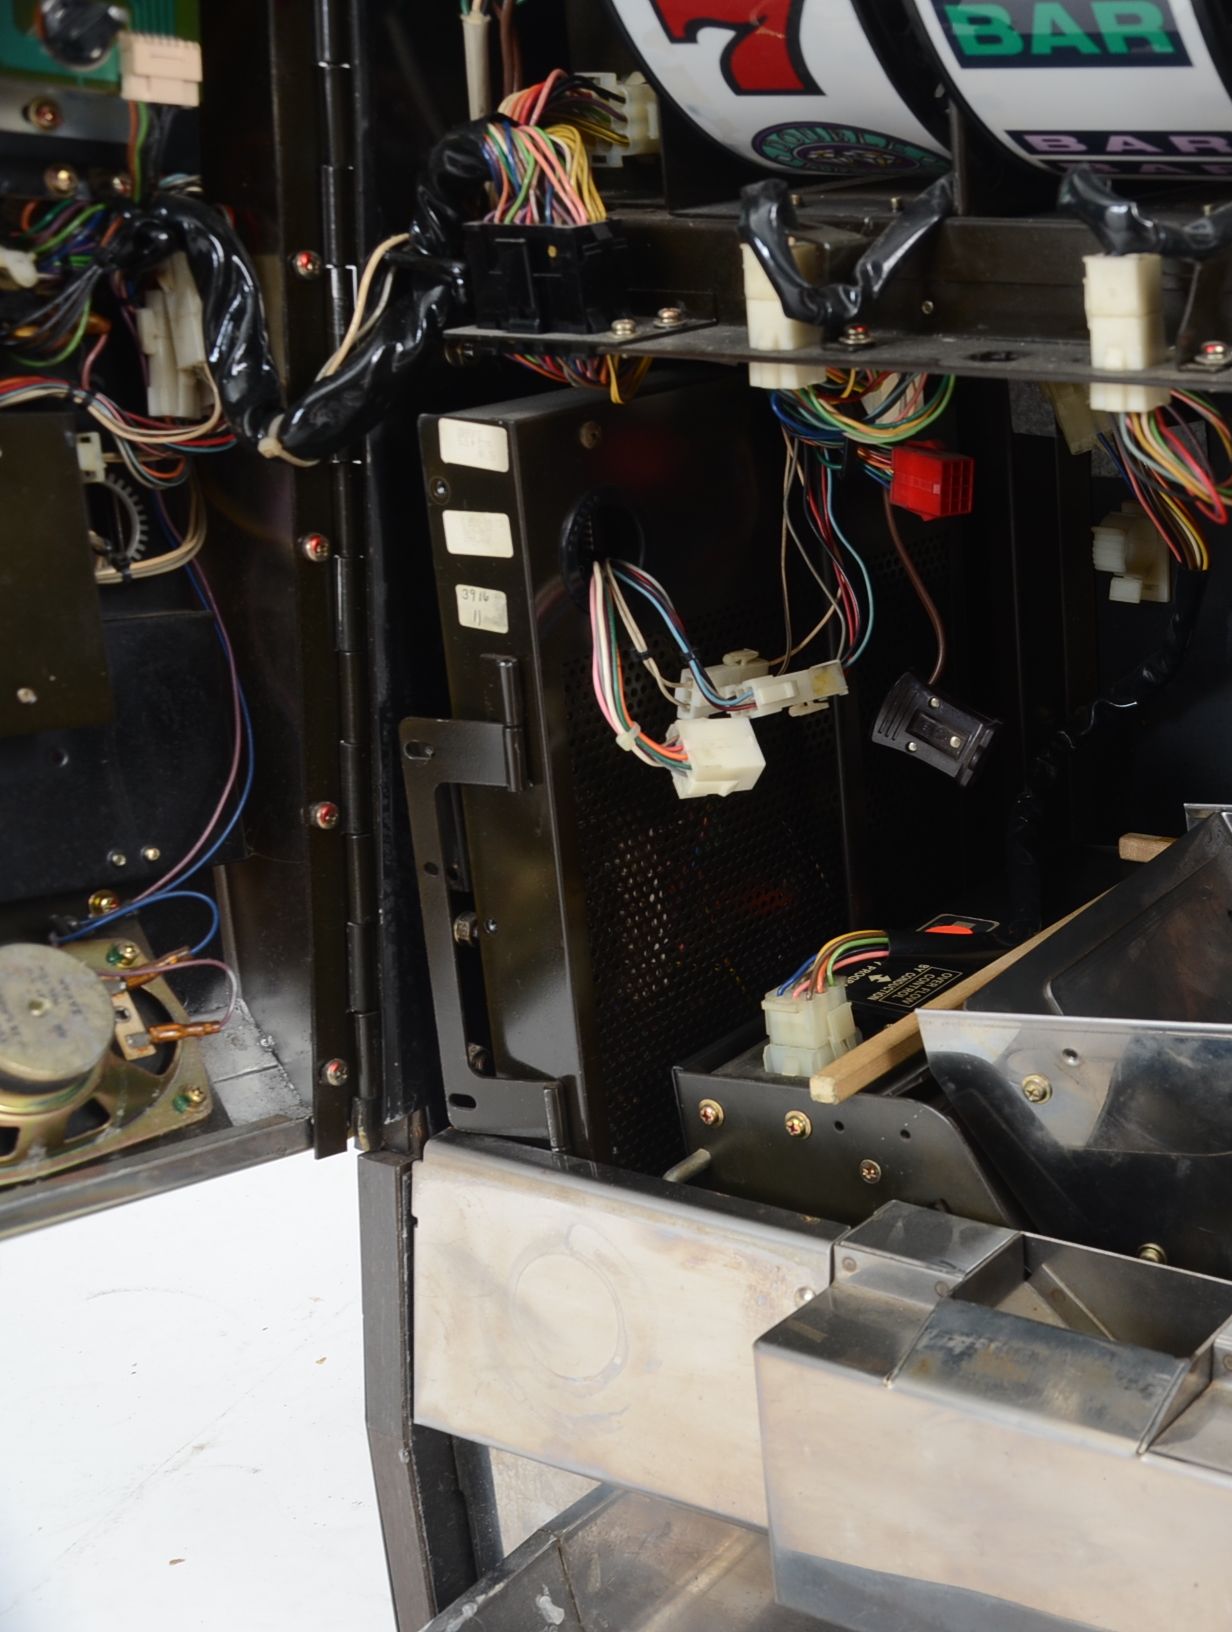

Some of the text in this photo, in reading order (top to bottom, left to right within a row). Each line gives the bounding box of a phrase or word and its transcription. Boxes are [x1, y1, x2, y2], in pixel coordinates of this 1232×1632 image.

[944, 1, 1175, 56] BAR
[867, 964, 930, 1001] BY CONDUCTION
[892, 973, 935, 999] CONTROL
[902, 972, 953, 1005] OVER FLOW
